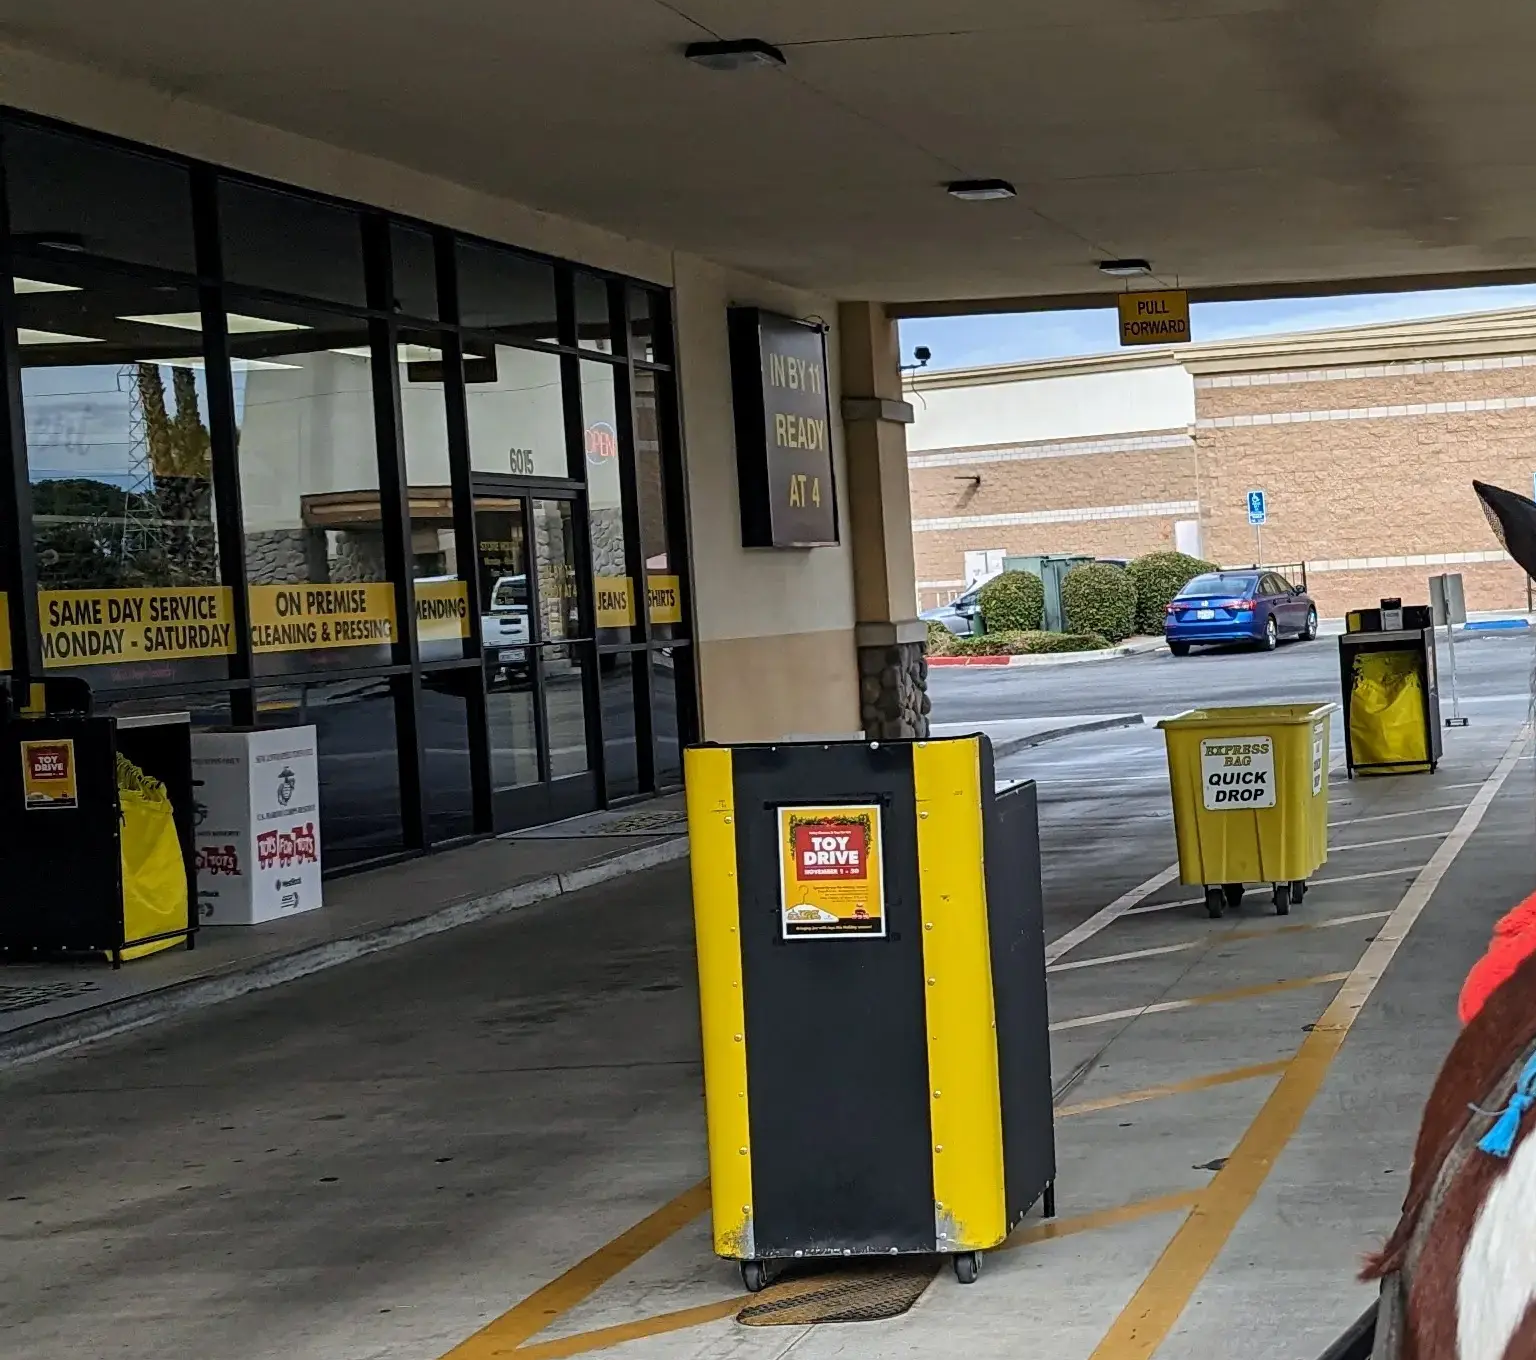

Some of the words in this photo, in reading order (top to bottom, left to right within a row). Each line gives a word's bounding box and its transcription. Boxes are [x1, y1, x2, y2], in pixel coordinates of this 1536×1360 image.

[1137, 300, 1169, 315] PULL
[1124, 319, 1185, 337] FORWARD
[769, 353, 786, 387] IN
[787, 356, 806, 390] BY
[809, 363, 822, 394] 11
[775, 413, 824, 451] READY
[585, 429, 616, 458] OPEN
[510, 448, 534, 475] 6015
[789, 474, 806, 508] AT
[812, 477, 820, 508] 4
[49, 598, 103, 627] SAME
[108, 597, 144, 624] DAY
[149, 595, 217, 622] SERVICE
[275, 591, 302, 617] ON
[306, 589, 367, 615] PREMISE
[597, 591, 627, 611] JEANS
[41, 628, 124, 659] MONDAY
[143, 623, 230, 652] SATURDAY
[251, 622, 317, 647] CLEANING
[321, 621, 331, 641] &
[335, 618, 391, 641] PRESSING
[37, 755, 59, 764] TOY
[1205, 743, 1270, 756] EXPRESS
[34, 763, 64, 772] DRIVE
[1223, 756, 1252, 767] BAG
[1208, 771, 1267, 786] QUICK
[1215, 788, 1265, 802] DROP
[259, 836, 276, 857] TOYS
[280, 837, 293, 855] FOR
[811, 836, 850, 851] TOY
[803, 850, 860, 866] DRIVE
